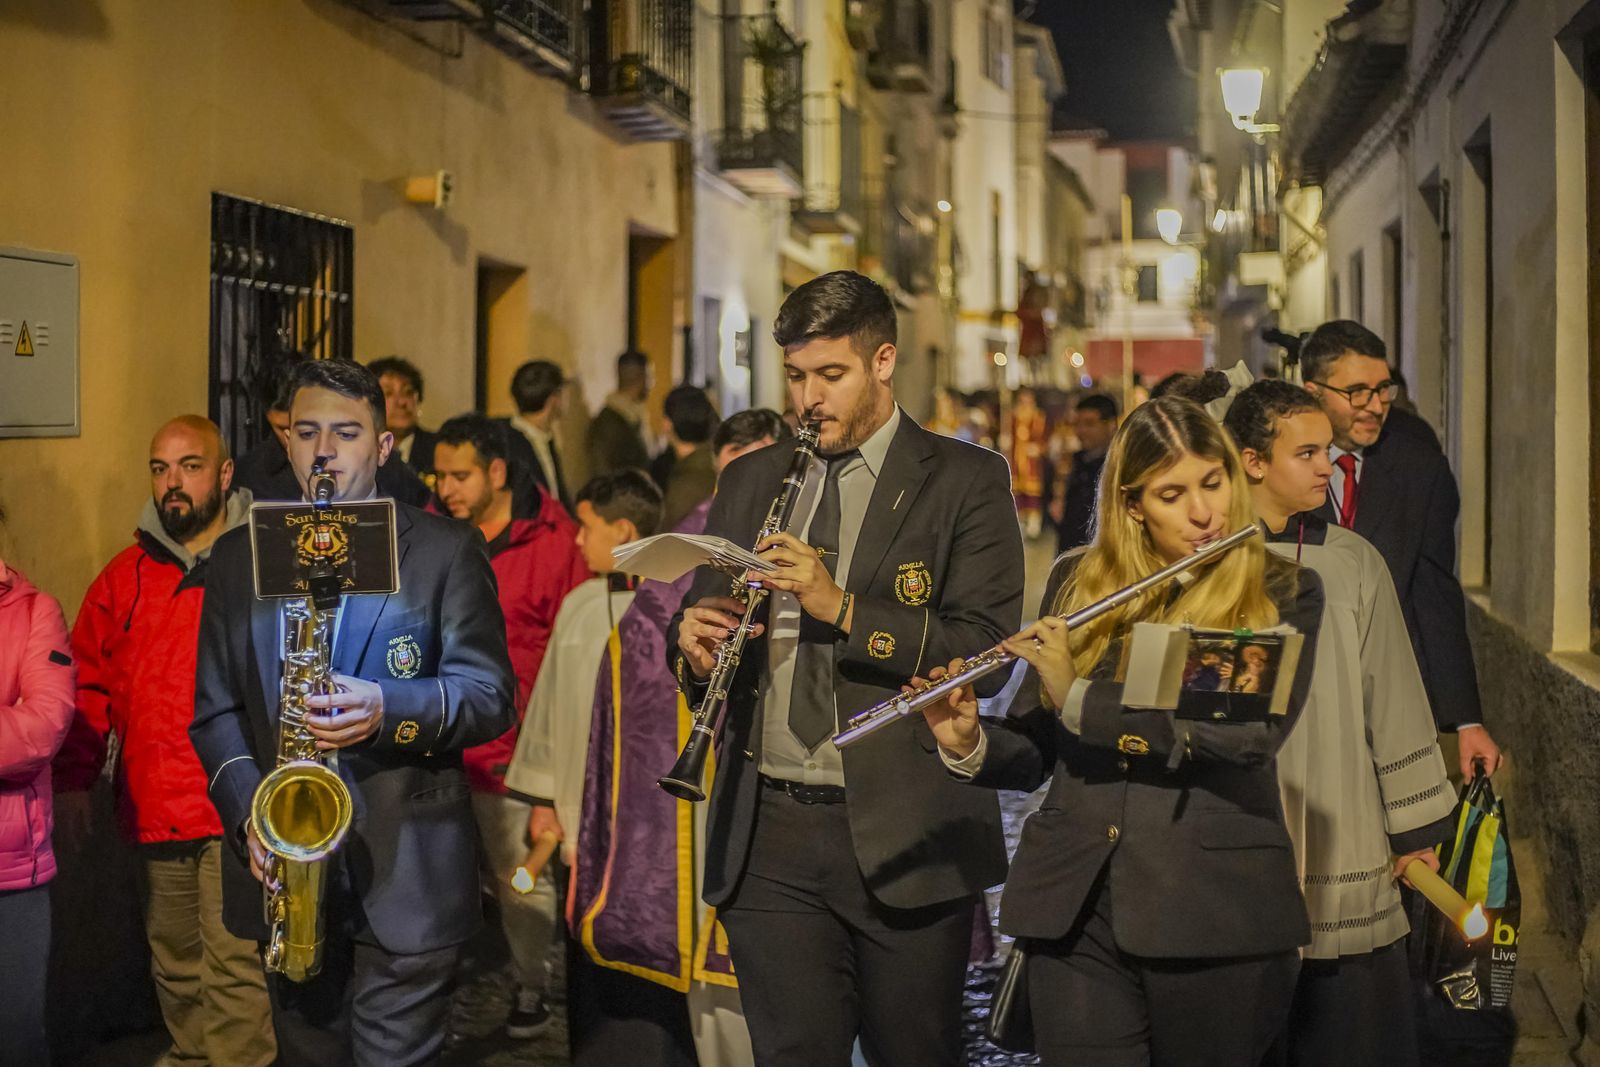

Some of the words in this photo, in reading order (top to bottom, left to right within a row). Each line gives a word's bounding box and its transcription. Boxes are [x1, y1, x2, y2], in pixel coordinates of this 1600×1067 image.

[285, 513, 314, 526] San
[319, 510, 358, 524] Isidro
[1493, 916, 1520, 946] b
[1491, 946, 1517, 962] Live
